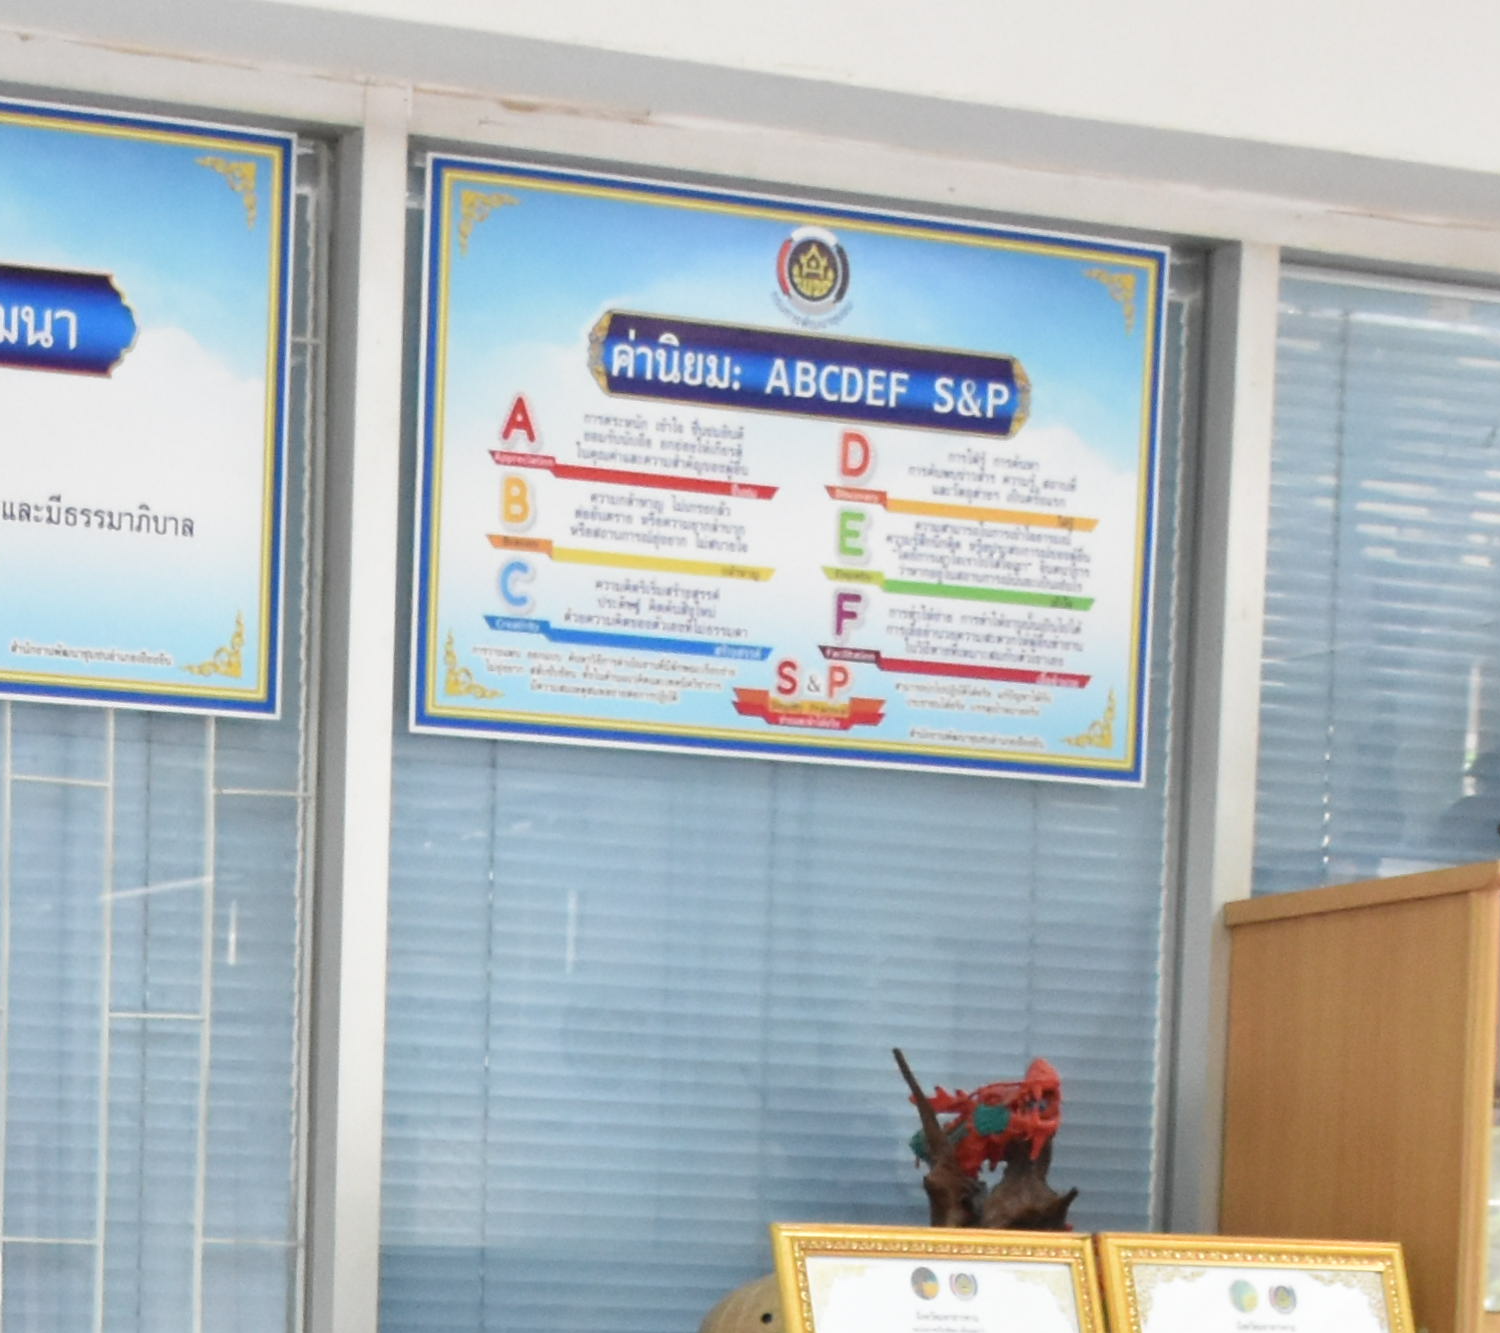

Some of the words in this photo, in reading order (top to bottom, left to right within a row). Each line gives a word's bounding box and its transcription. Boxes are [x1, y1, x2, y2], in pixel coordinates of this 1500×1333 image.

[611, 330, 742, 392] ค่านิยม:
[765, 357, 909, 411] ABCDEF
[933, 376, 1010, 418] S&P
[501, 395, 537, 443] A
[841, 431, 870, 477] D
[2, 494, 195, 537] และมีธรรมาภิบาล
[503, 476, 530, 524] B
[838, 510, 865, 557] E
[499, 560, 530, 608] C
[835, 592, 863, 637] F
[777, 660, 798, 695] S
[806, 673, 821, 693] &
[828, 665, 849, 699] P
